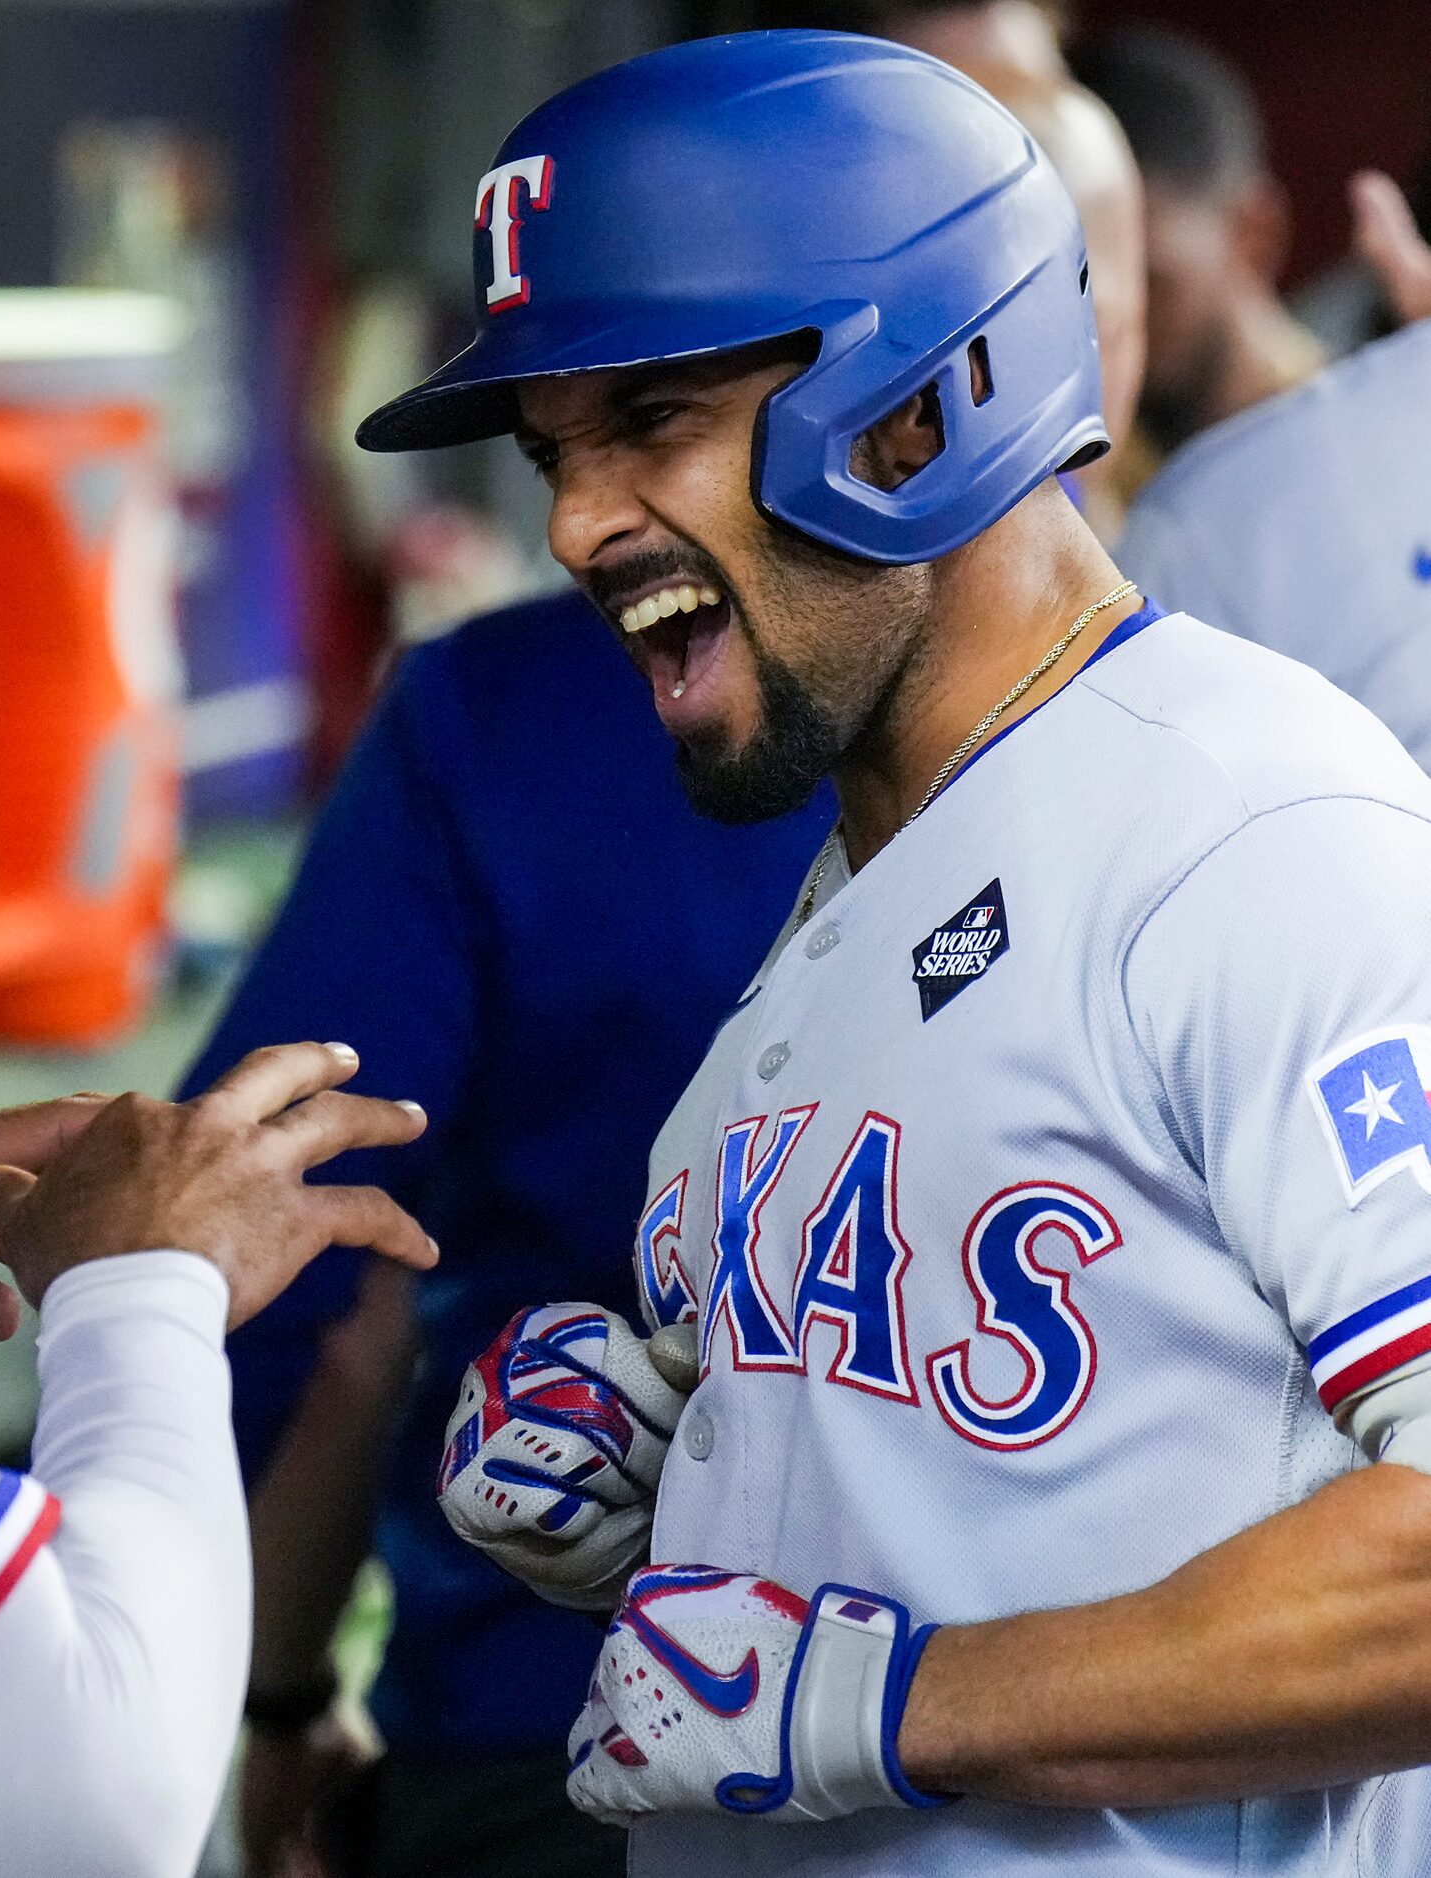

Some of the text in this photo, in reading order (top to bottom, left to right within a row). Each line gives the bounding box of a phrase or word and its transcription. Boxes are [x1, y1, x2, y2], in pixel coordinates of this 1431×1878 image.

[474, 154, 554, 315] T
[931, 929, 1001, 953] WORLD
[916, 951, 991, 977] SERIES
